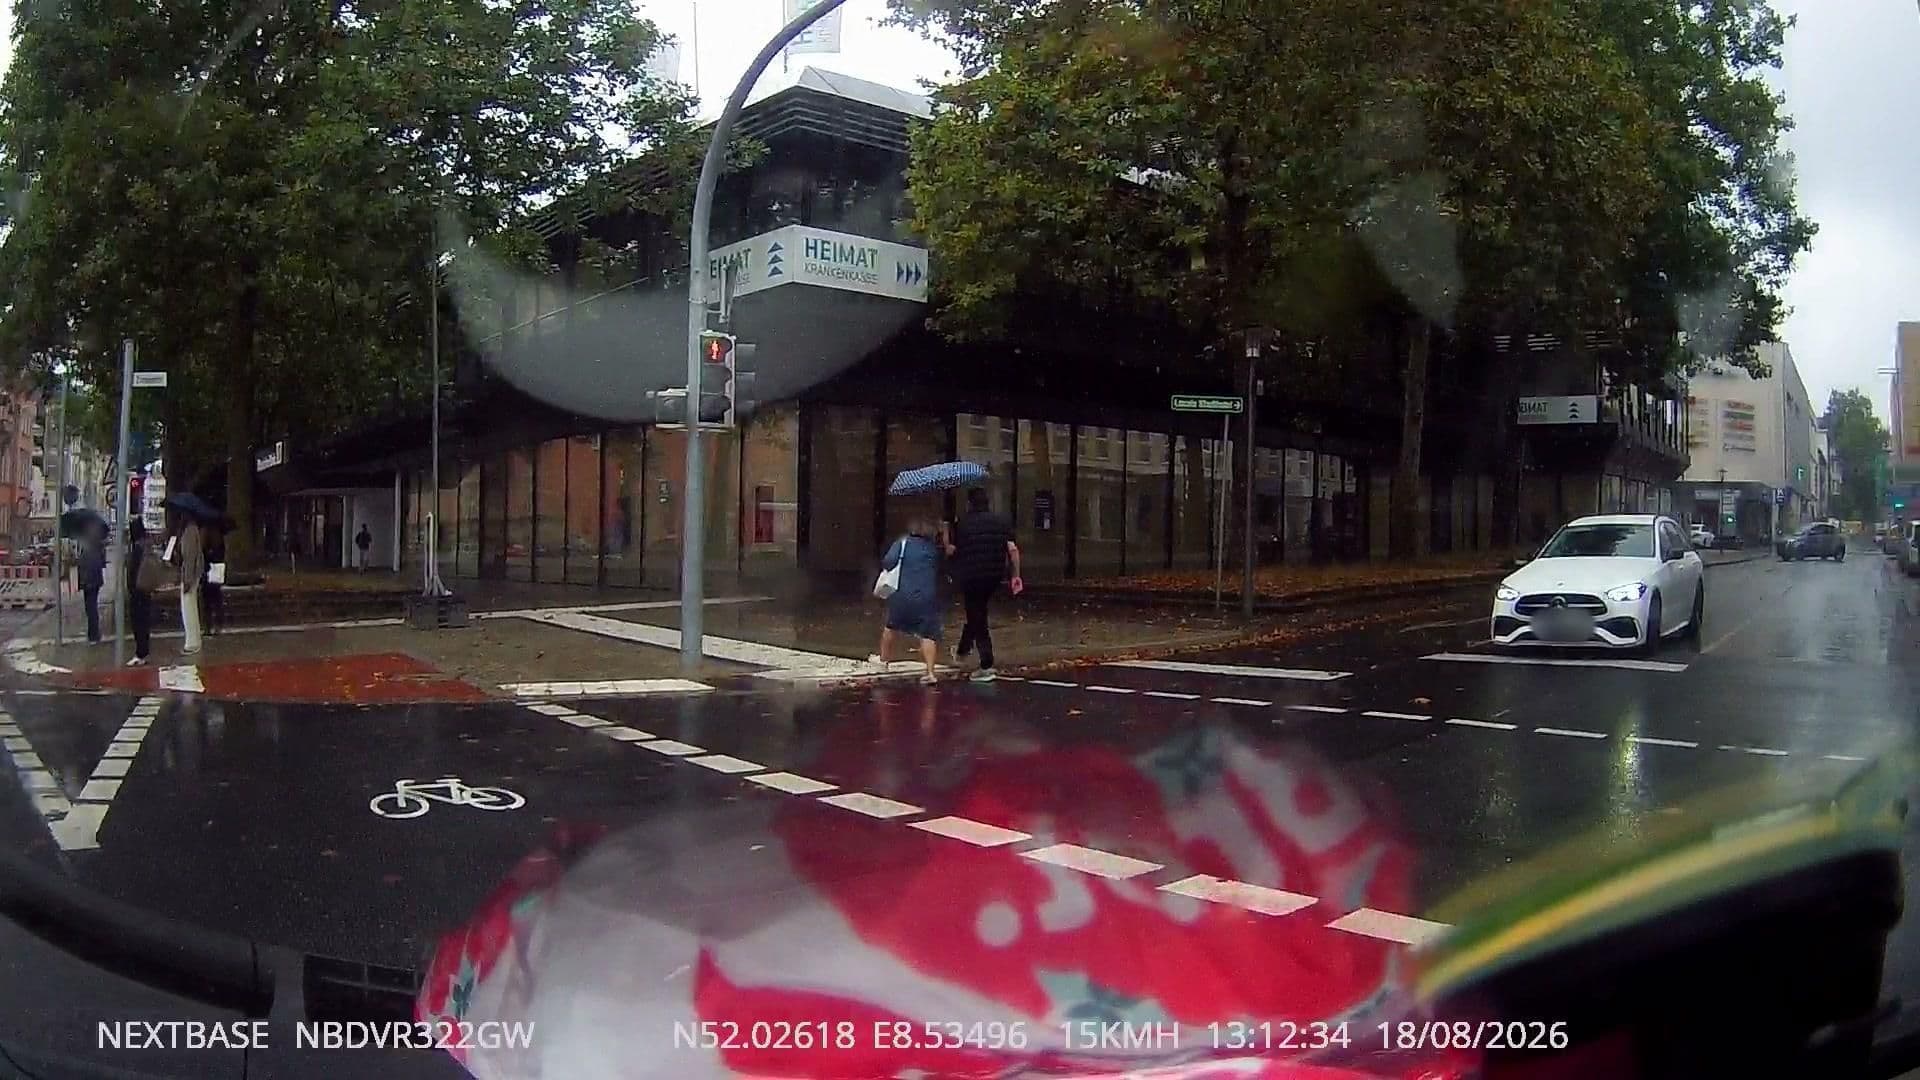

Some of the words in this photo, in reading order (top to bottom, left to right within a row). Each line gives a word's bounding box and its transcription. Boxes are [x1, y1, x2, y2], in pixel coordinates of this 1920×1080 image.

[709, 247, 751, 279] EIMAT
[804, 237, 878, 268] HEIMAT
[804, 261, 878, 285] KRANKENKASSE
